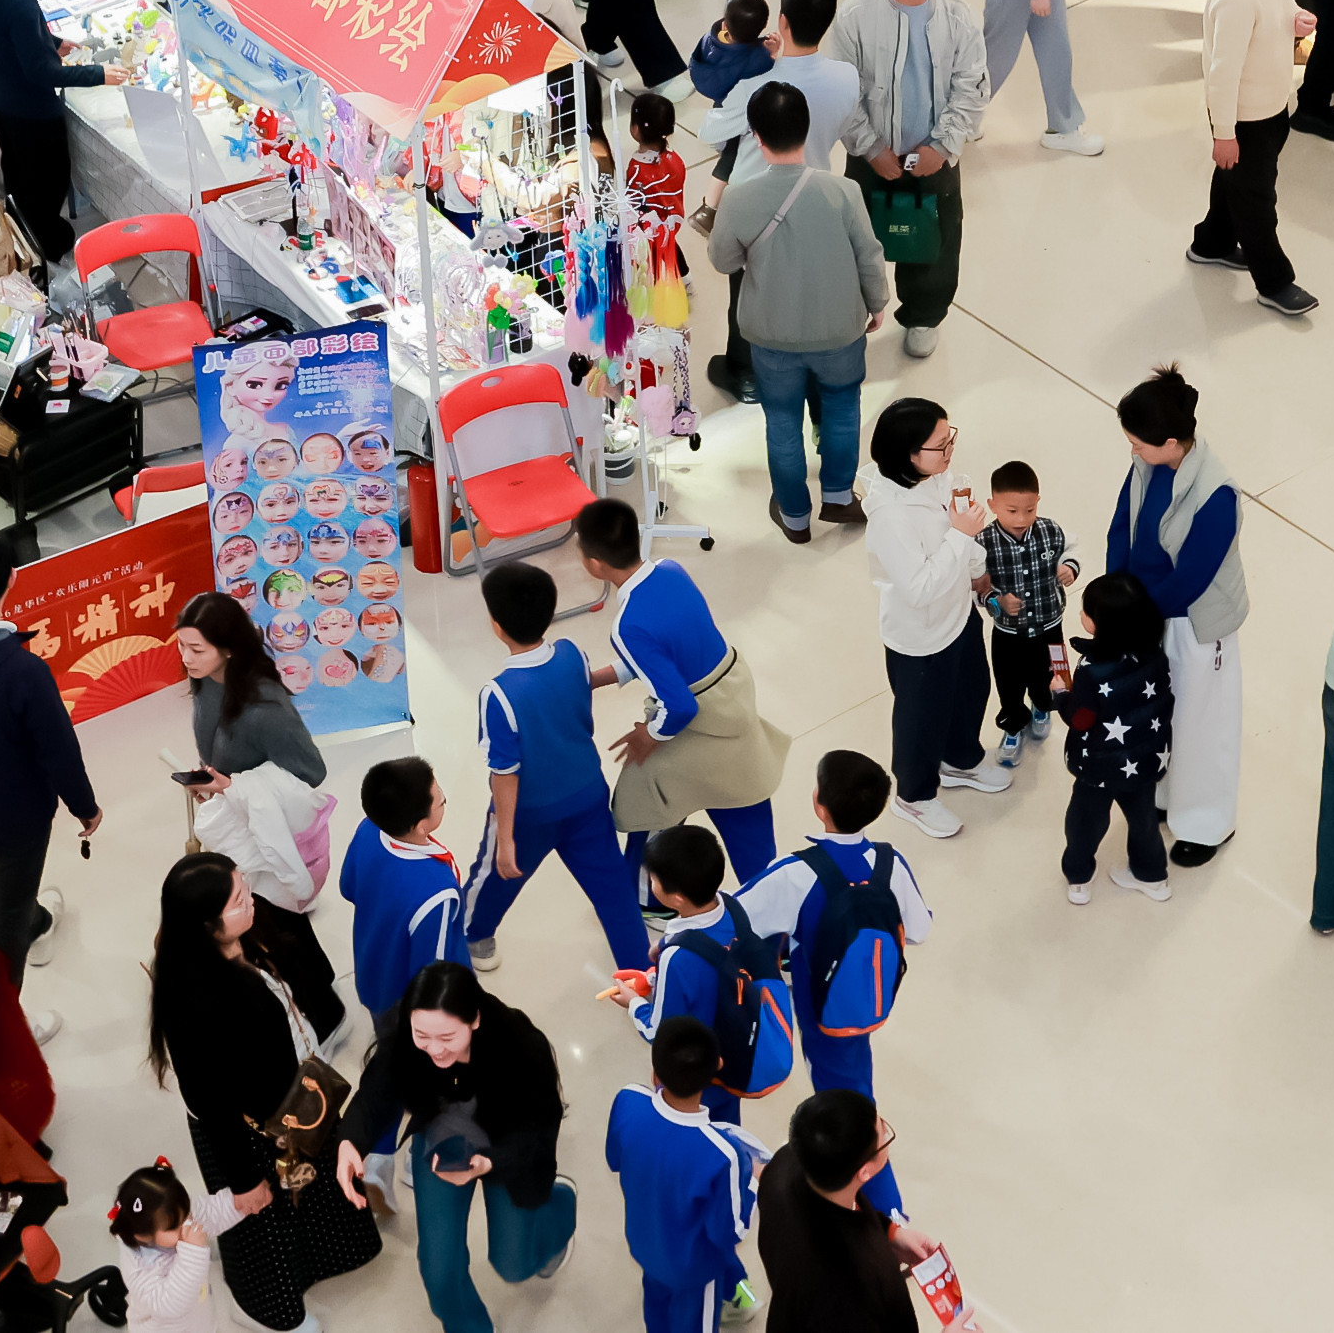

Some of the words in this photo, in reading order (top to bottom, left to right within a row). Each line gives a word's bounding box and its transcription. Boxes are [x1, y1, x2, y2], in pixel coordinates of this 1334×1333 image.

[202, 332, 378, 373] 儿童面部彩绘
